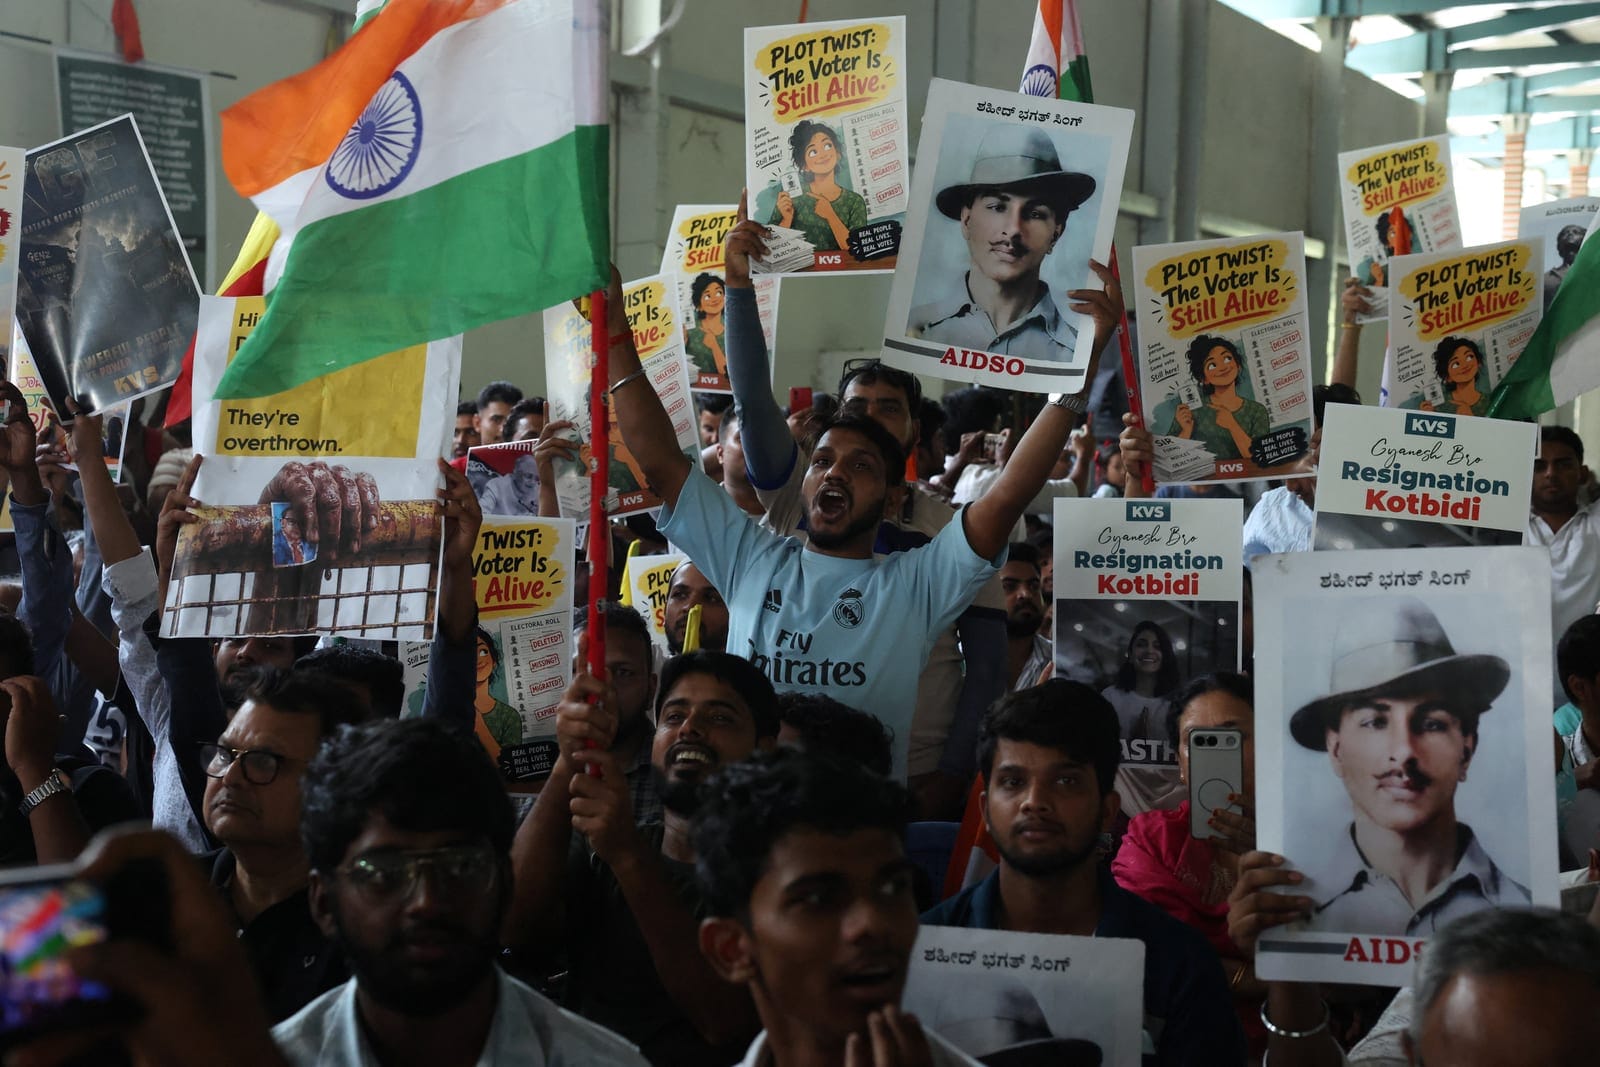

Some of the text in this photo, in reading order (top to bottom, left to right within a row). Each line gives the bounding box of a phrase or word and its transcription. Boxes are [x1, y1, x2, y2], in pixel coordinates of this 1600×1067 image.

[771, 29, 875, 68] PLOT TWIST:
[769, 49, 881, 91] The Voter Is
[777, 74, 886, 115] Still Alive.
[977, 101, 1083, 126] ಶಹೀದ್ ಭಗತ್ ಸಿಂಗ್
[1358, 145, 1429, 179] PLOT TWIST:
[1358, 160, 1435, 195] The Voter Is
[1364, 190, 1393, 211] Still
[1398, 175, 1440, 197] Alive.
[690, 216, 726, 234] PLOT
[686, 234, 712, 249] The
[686, 246, 720, 267] Still
[818, 255, 842, 265] KVS
[1162, 244, 1273, 285] PLOT TWIST:
[1416, 250, 1517, 292] PLOT TWIST:
[1161, 264, 1279, 308] The Voter Is
[1414, 268, 1521, 313] The Voter Is
[646, 305, 659, 322] Is
[1171, 288, 1286, 331] Still Alive.
[1421, 300, 1463, 334] Still
[1470, 290, 1525, 318] Alive.
[940, 347, 1025, 376] AIDSO
[113, 364, 158, 394] KVS
[227, 409, 299, 429] They're
[1412, 419, 1448, 434] KVS
[223, 435, 343, 451] overthrown.
[1155, 438, 1172, 446] SIR
[1371, 438, 1483, 468] Gyanesh Bro
[1220, 464, 1243, 472] KVS
[1342, 461, 1509, 496] Resignation
[623, 494, 643, 506] KVS
[1132, 506, 1164, 518] KVS
[1365, 489, 1482, 521] Kotbidi
[481, 529, 542, 550] TWIST:
[1098, 525, 1198, 554] Gyanesh Bro
[531, 551, 547, 572] Is
[1075, 549, 1223, 573] Resignation
[484, 576, 551, 603] Alive.
[1098, 573, 1198, 595] Kotbidi
[1320, 569, 1471, 589] ಶಹೀದ್ ಭಗತ್ ಸಿಂಗ್
[510, 620, 543, 631] ELECTORAL
[533, 635, 561, 648] DELETED?
[776, 629, 813, 654] Fly
[532, 656, 557, 669] MISSING?
[532, 679, 562, 692] MIGRATED?
